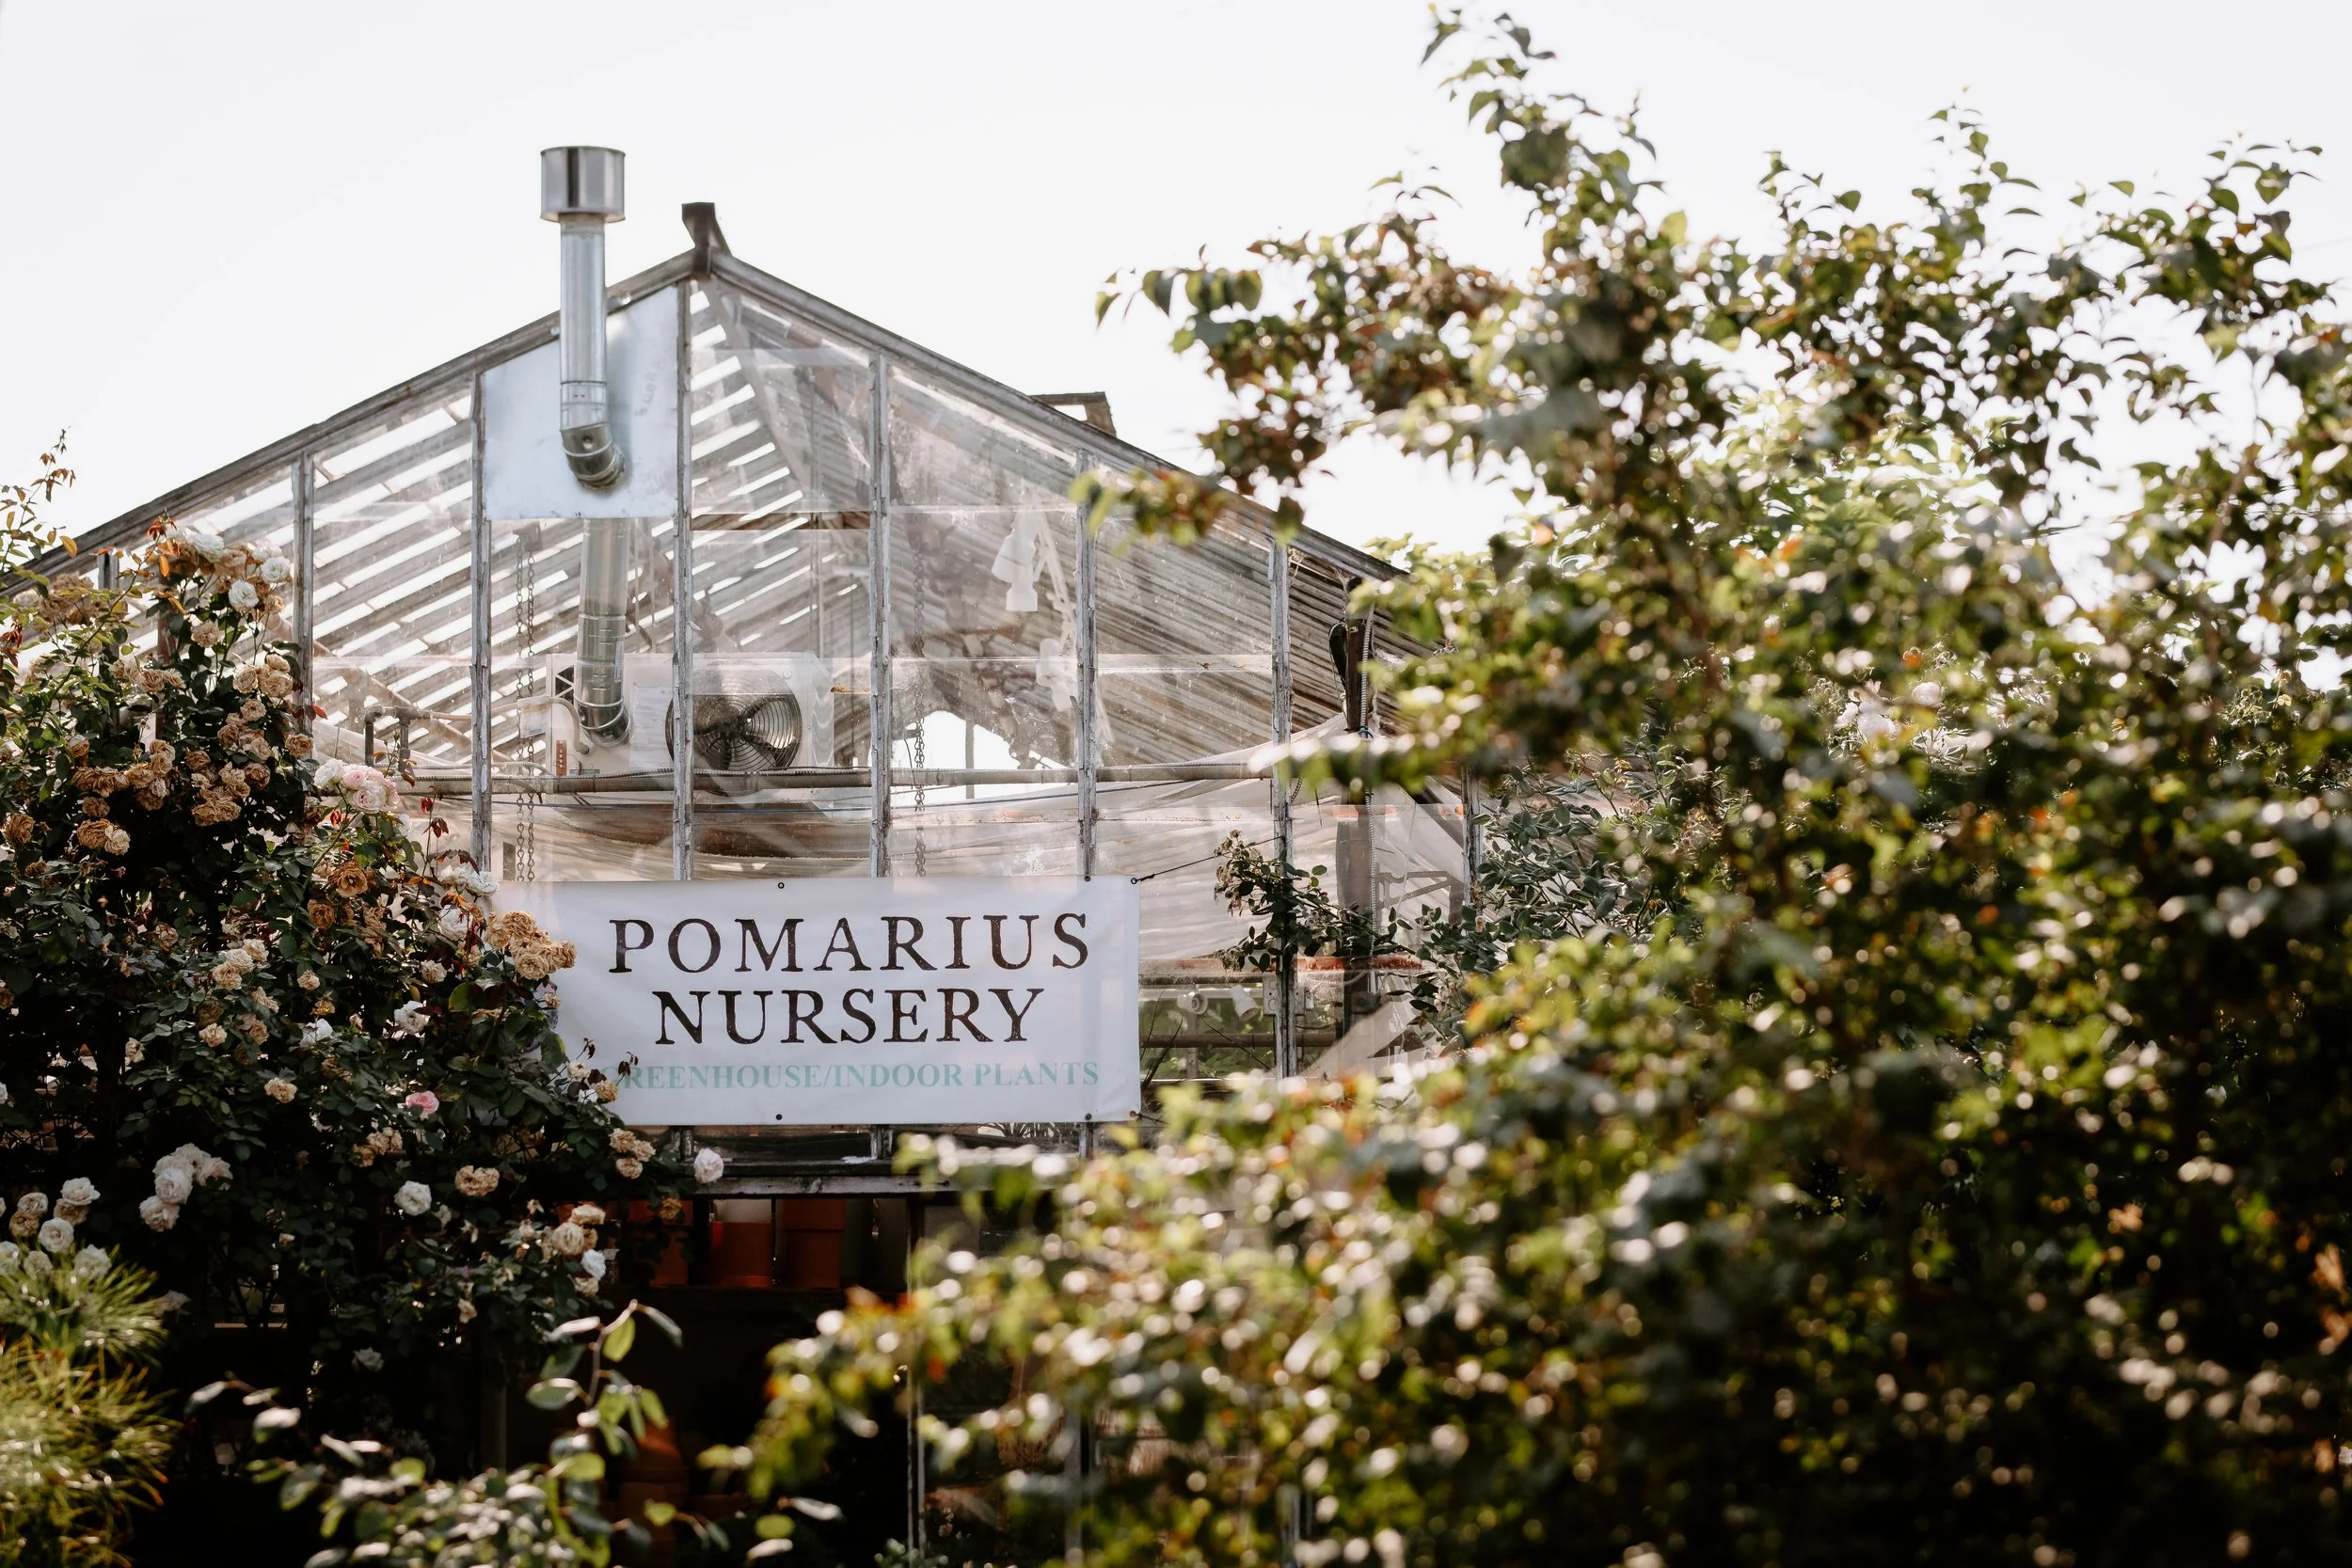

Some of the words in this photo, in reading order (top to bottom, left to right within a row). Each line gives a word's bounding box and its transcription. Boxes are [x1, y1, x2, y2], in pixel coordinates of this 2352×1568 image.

[609, 912, 1089, 974] POMARIUS
[652, 988, 1044, 1045] NURSERY
[973, 1061, 1099, 1086] PLANTS
